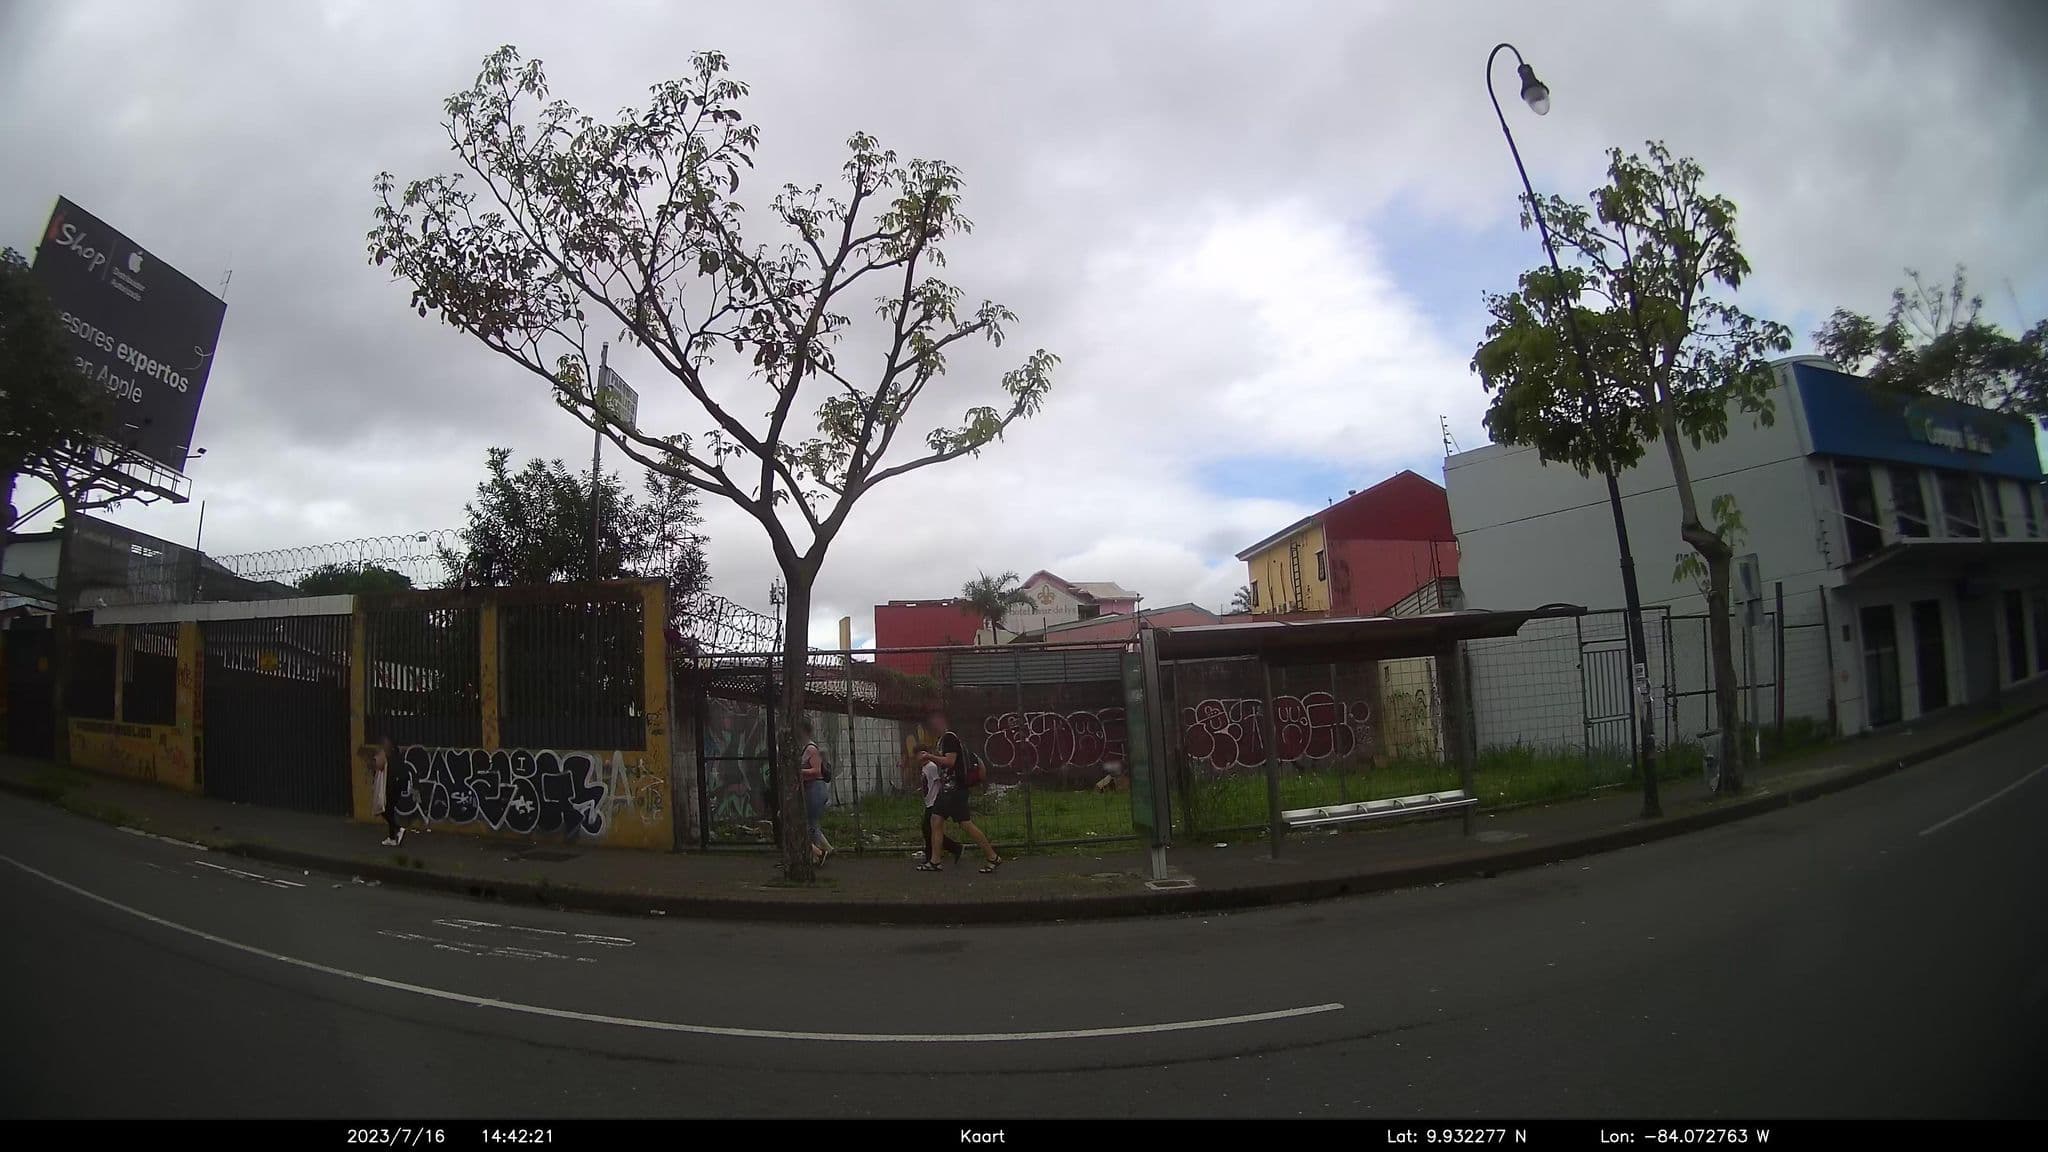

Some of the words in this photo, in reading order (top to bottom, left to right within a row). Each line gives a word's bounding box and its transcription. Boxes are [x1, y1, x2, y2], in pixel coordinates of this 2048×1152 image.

[60, 311, 115, 352] esores
[117, 342, 189, 393] expertos
[96, 365, 143, 403] Apple
